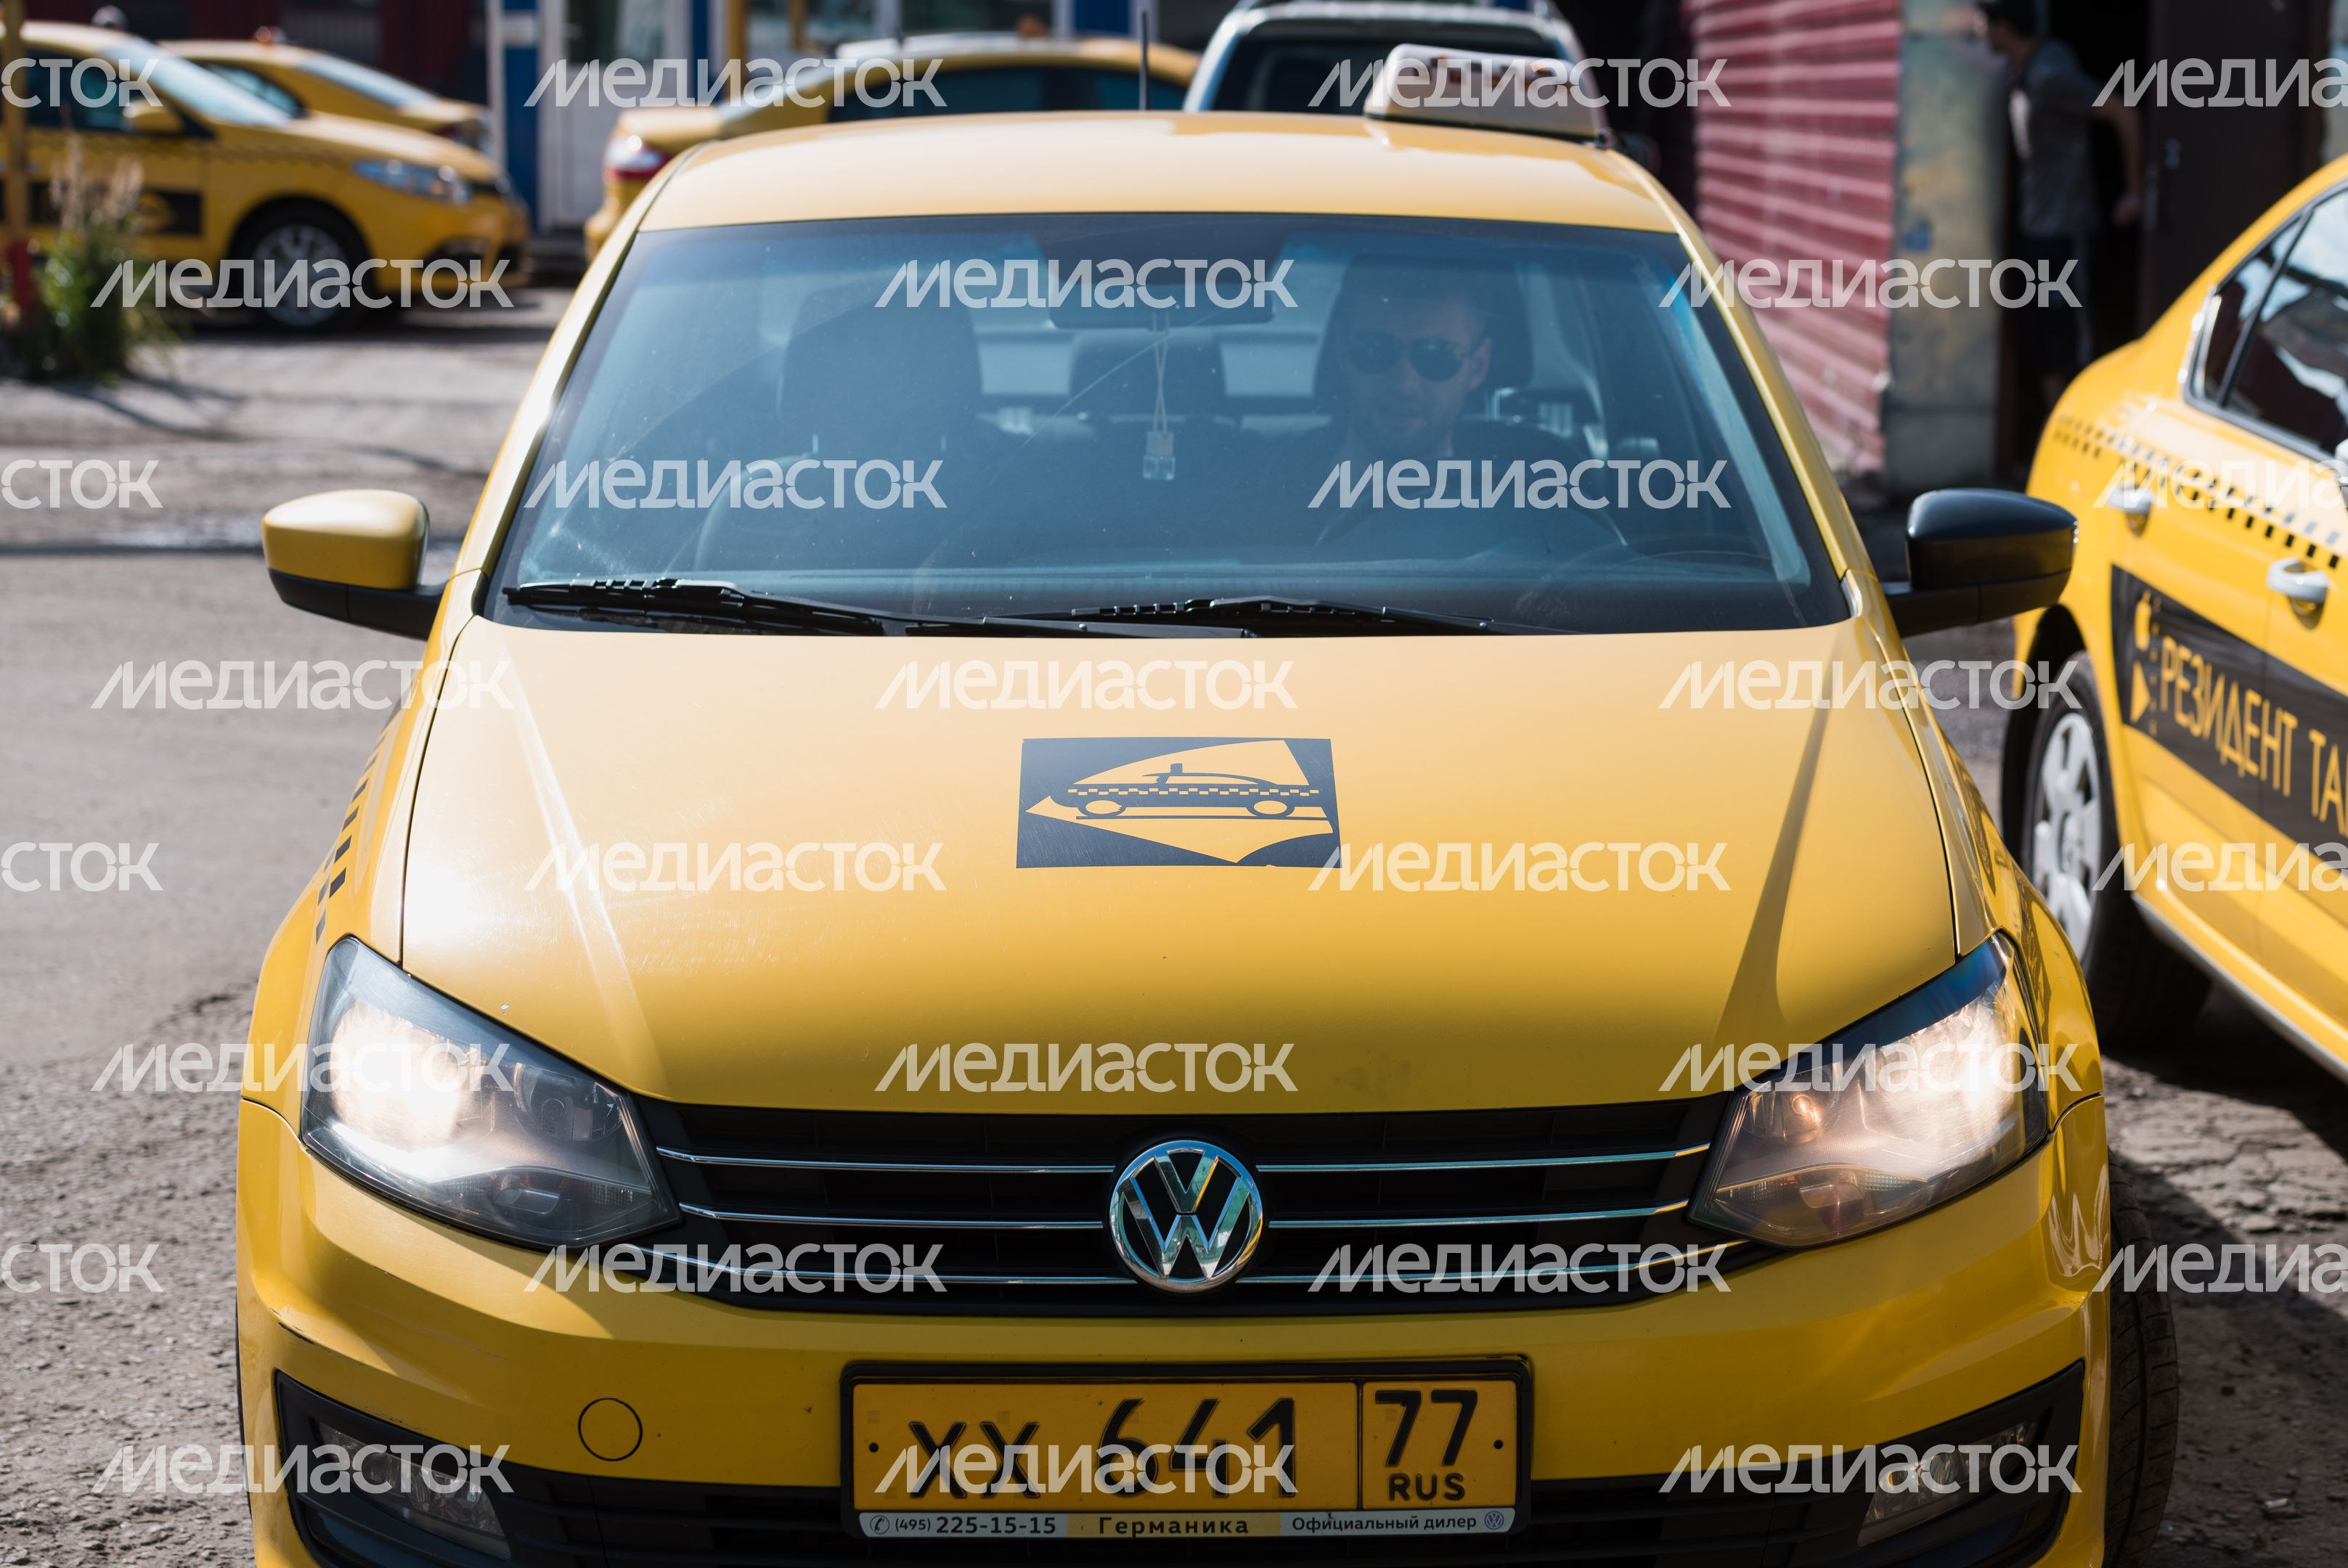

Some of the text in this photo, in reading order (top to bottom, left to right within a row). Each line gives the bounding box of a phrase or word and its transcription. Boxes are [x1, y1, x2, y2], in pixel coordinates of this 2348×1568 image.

[2160, 635, 2348, 838] РЕЗИДЕНТ ТА
[1096, 1397, 1296, 1498] 641
[1375, 1389, 1478, 1466] 77
[1388, 1473, 1465, 1501] RUS
[894, 1517, 932, 1532] (495)
[936, 1516, 1056, 1534] 225-15-15
[1098, 1516, 1250, 1538] Германика
[1292, 1516, 1419, 1533] Официальный
[1424, 1516, 1477, 1531] дилер
